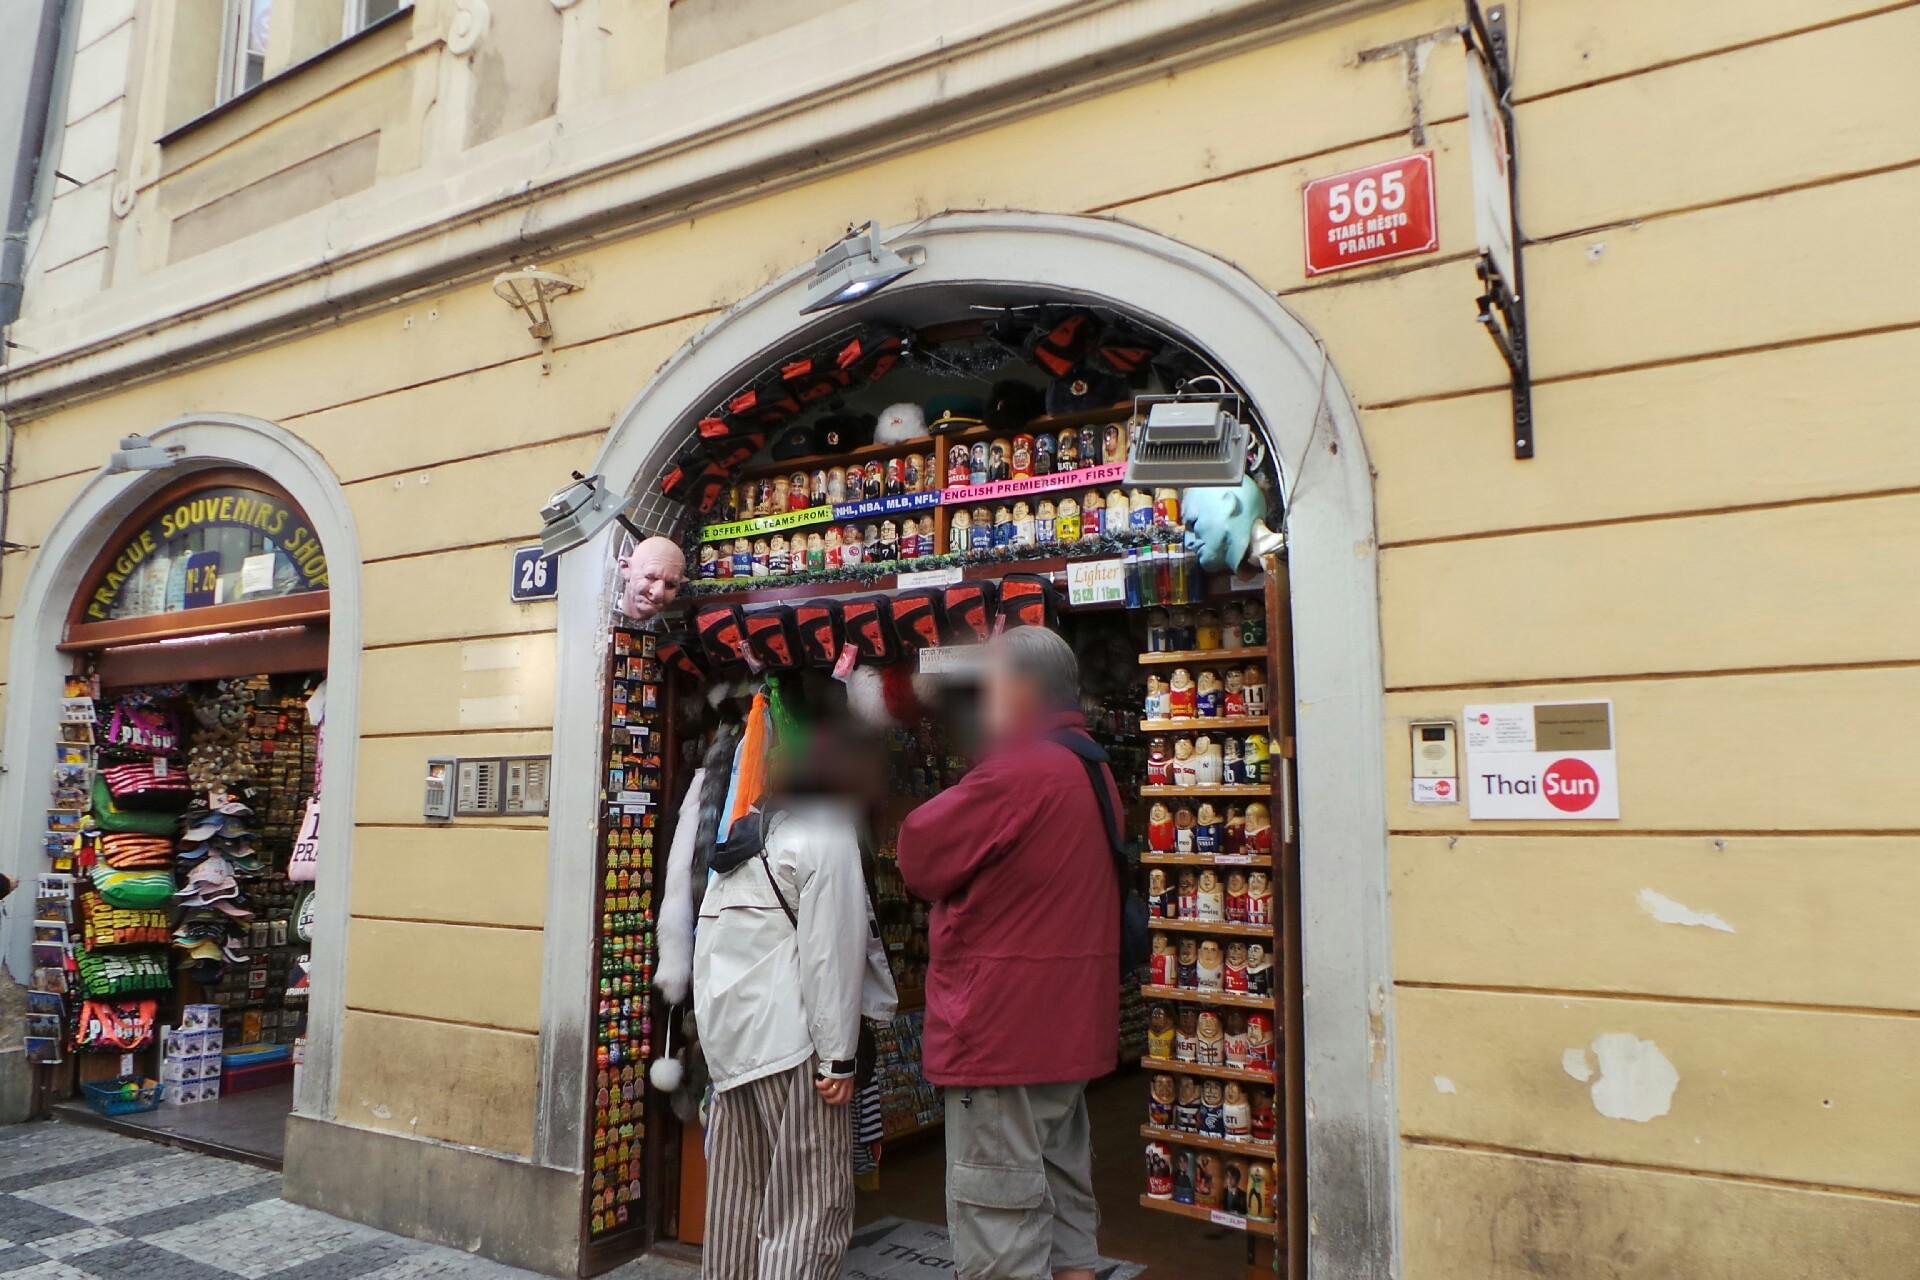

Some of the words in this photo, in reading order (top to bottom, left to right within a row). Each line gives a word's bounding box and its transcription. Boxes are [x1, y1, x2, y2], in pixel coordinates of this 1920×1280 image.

[1328, 170, 1406, 223] 565
[1328, 219, 1364, 242] STARÉ
[1367, 213, 1408, 233] MĚSTO
[1339, 233, 1385, 256] PRAHA
[1390, 230, 1398, 244] 1
[945, 486, 993, 500] ENGLISH
[997, 475, 1082, 494] PREMIERSHIP,
[836, 506, 858, 517] NHL,
[859, 501, 884, 514] NBA,
[886, 497, 912, 510] MLB,
[914, 494, 939, 506] NFL,
[744, 523, 760, 534] ALL
[764, 517, 795, 529] TEAMS
[797, 510, 830, 523] FROM:
[88, 530, 157, 619] PRAGUE
[161, 496, 288, 538] SOUVENIRS
[284, 527, 329, 587] SHOP
[202, 564, 217, 591] 26
[521, 559, 547, 590] 26
[1073, 563, 1120, 587] Lighter
[1418, 783, 1434, 791] Thai
[1435, 783, 1450, 792] Sun
[1481, 774, 1537, 795] Thai
[1545, 772, 1595, 796] Sun
[880, 1243, 955, 1268] Thai
